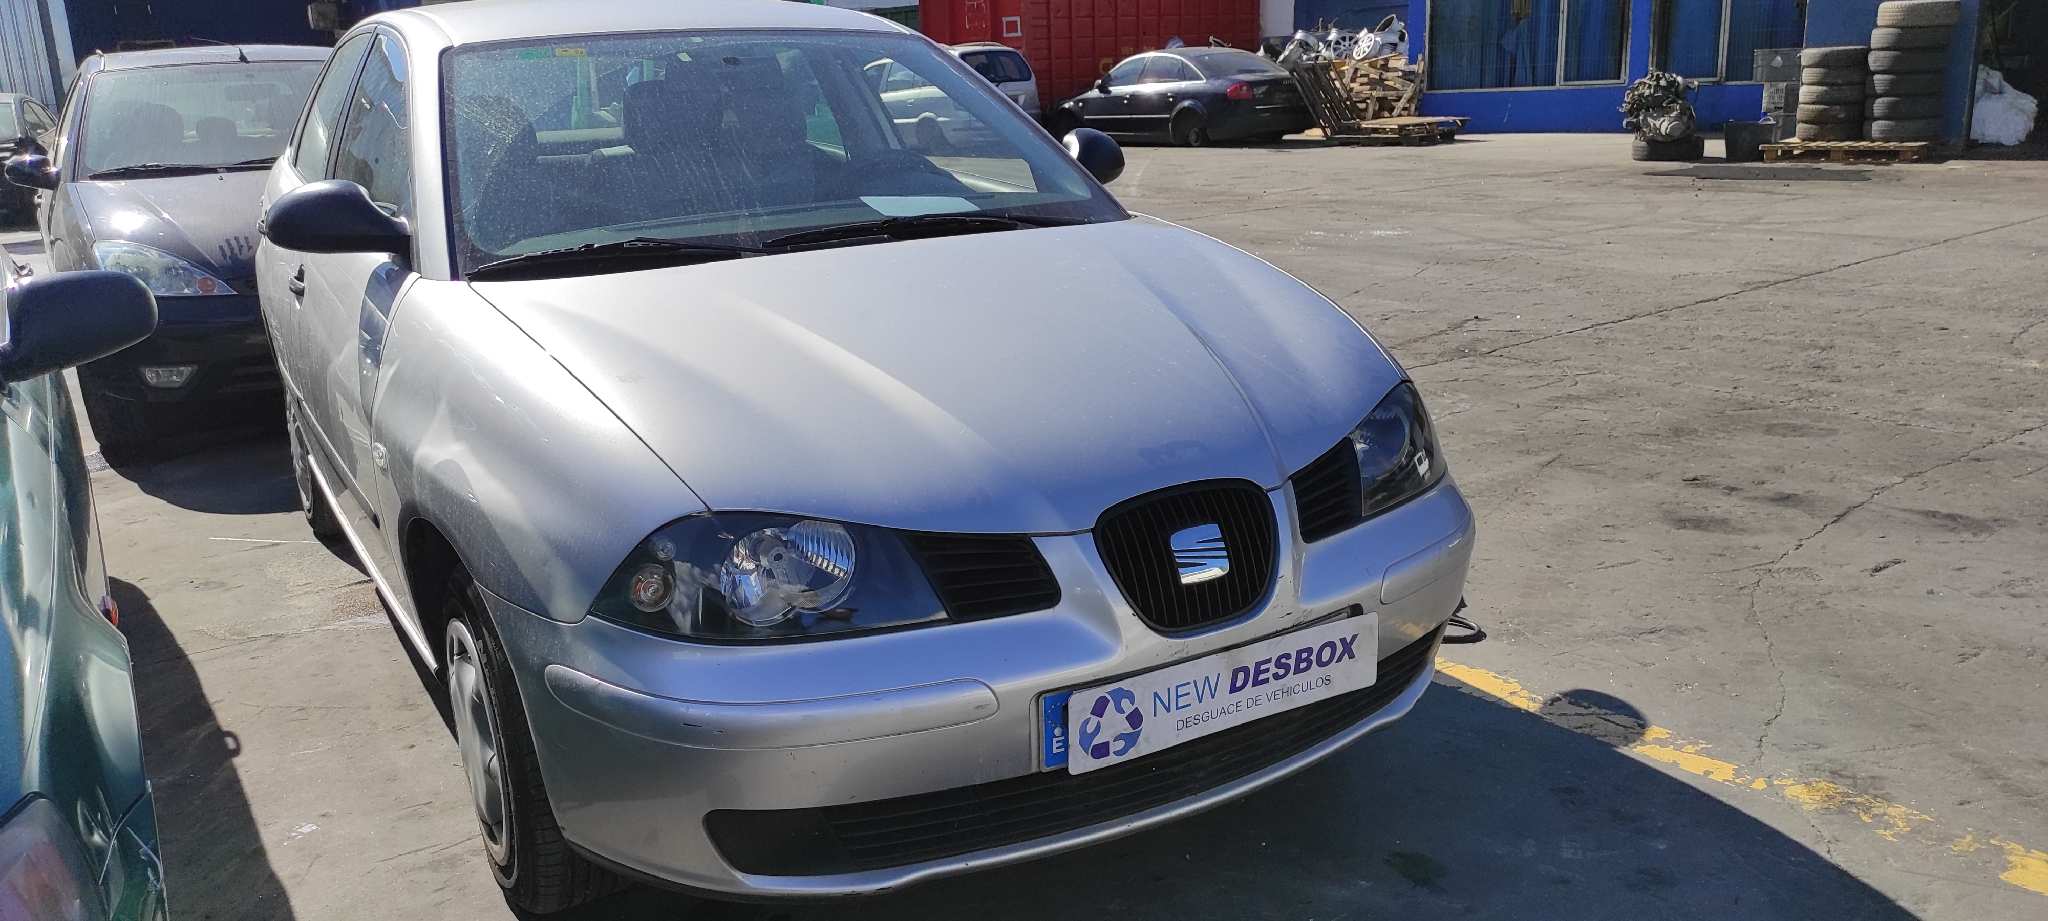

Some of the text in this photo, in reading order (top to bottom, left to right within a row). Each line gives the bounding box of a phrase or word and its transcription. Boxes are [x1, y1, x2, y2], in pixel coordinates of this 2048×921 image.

[1152, 633, 1360, 718] NEW DESBOX
[1176, 674, 1332, 732] DESGUACE DE VEHICULOS
[1052, 735, 1065, 754] E
